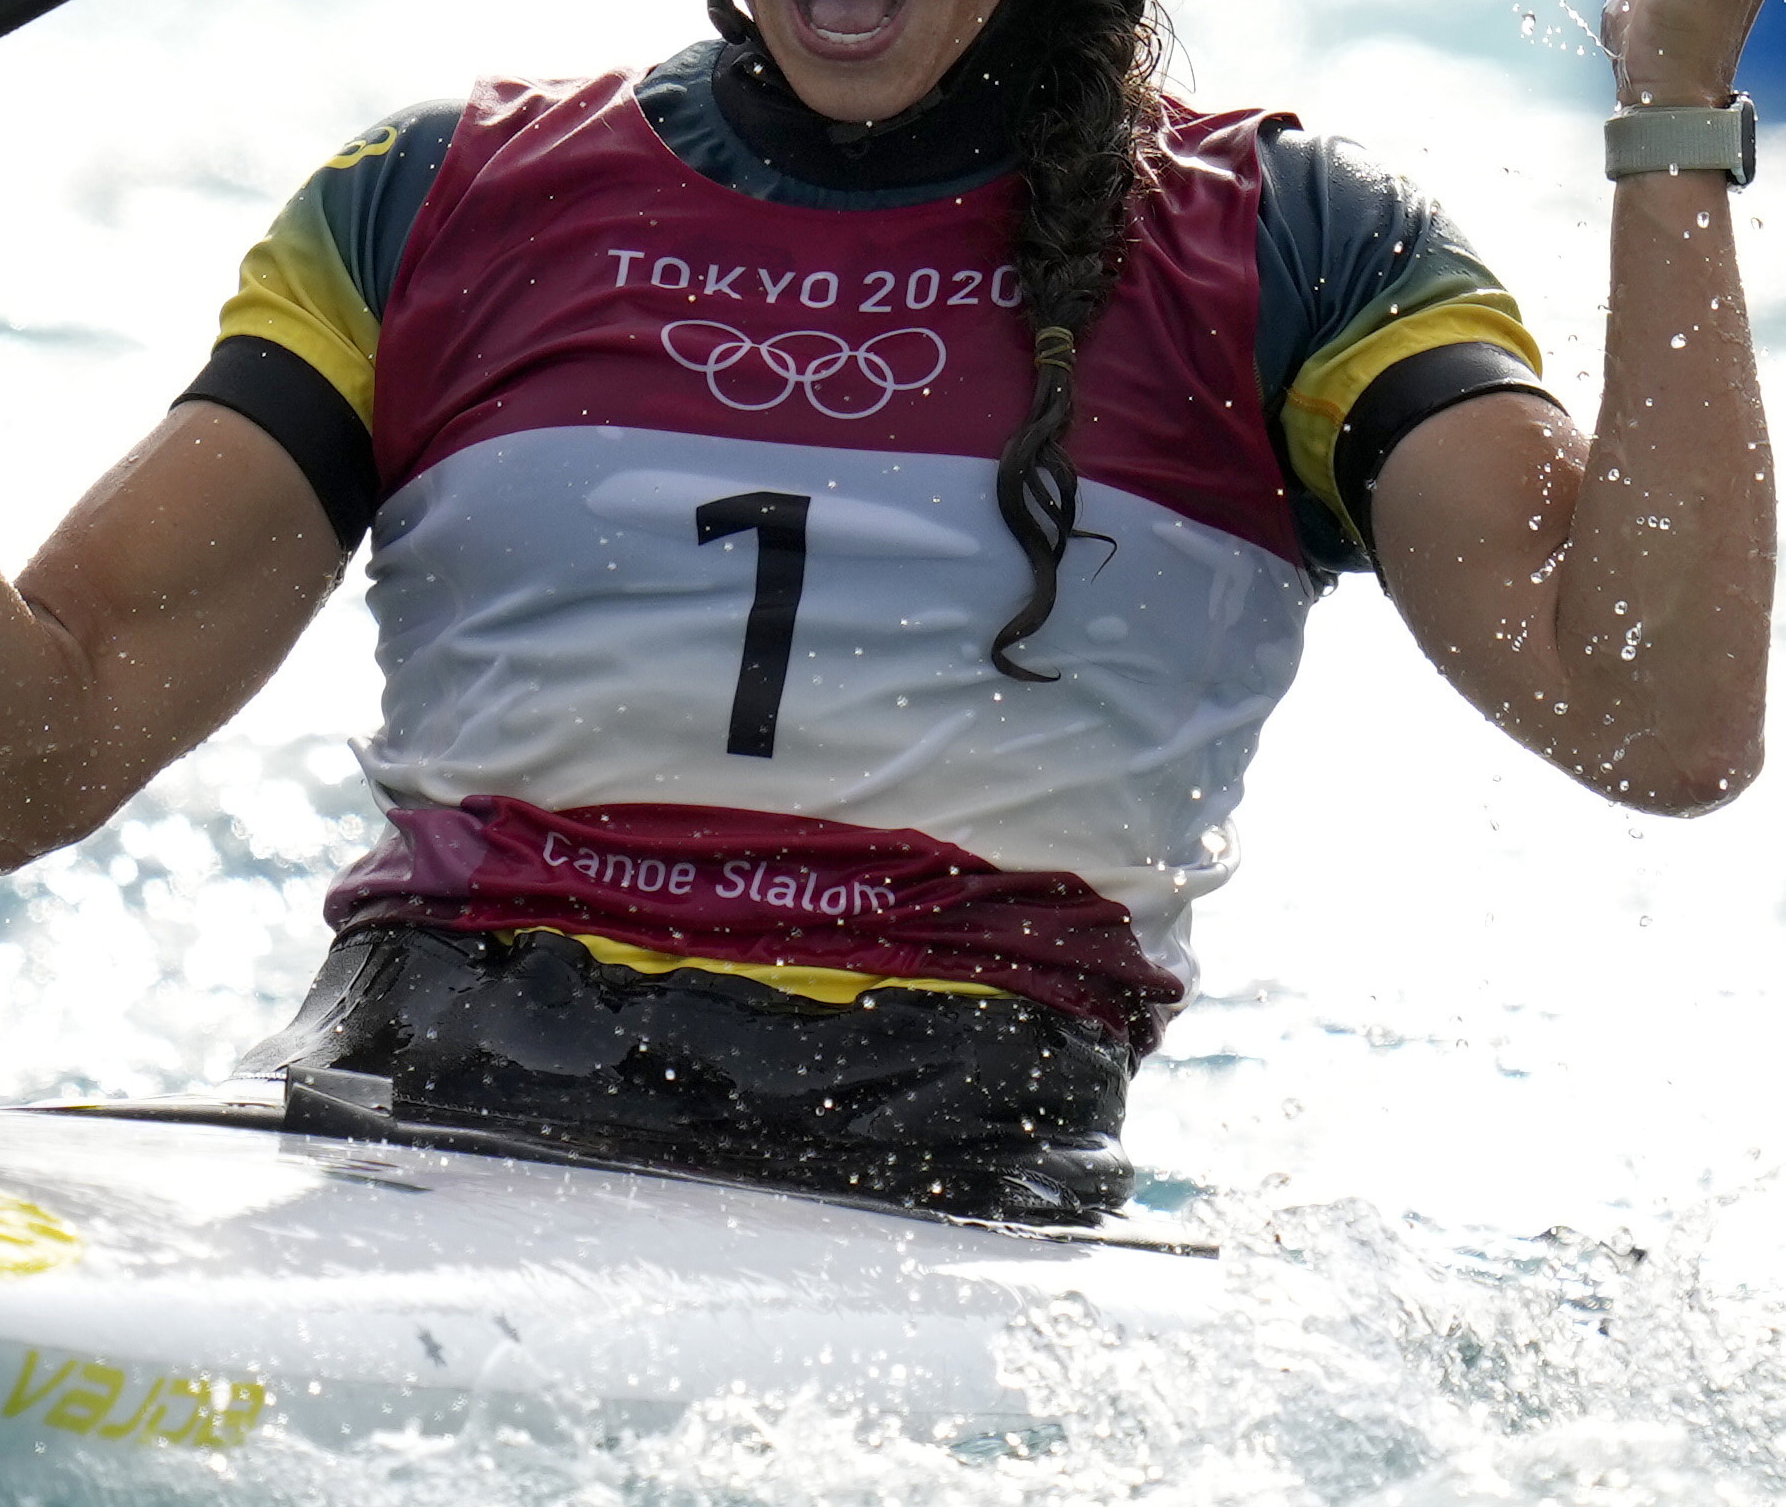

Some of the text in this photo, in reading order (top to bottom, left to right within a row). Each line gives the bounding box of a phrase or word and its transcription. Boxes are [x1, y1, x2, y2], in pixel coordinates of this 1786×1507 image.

[607, 249, 1023, 313] TOKYO 2020
[695, 491, 812, 759] 1
[542, 830, 896, 917] Canoe Slalom
